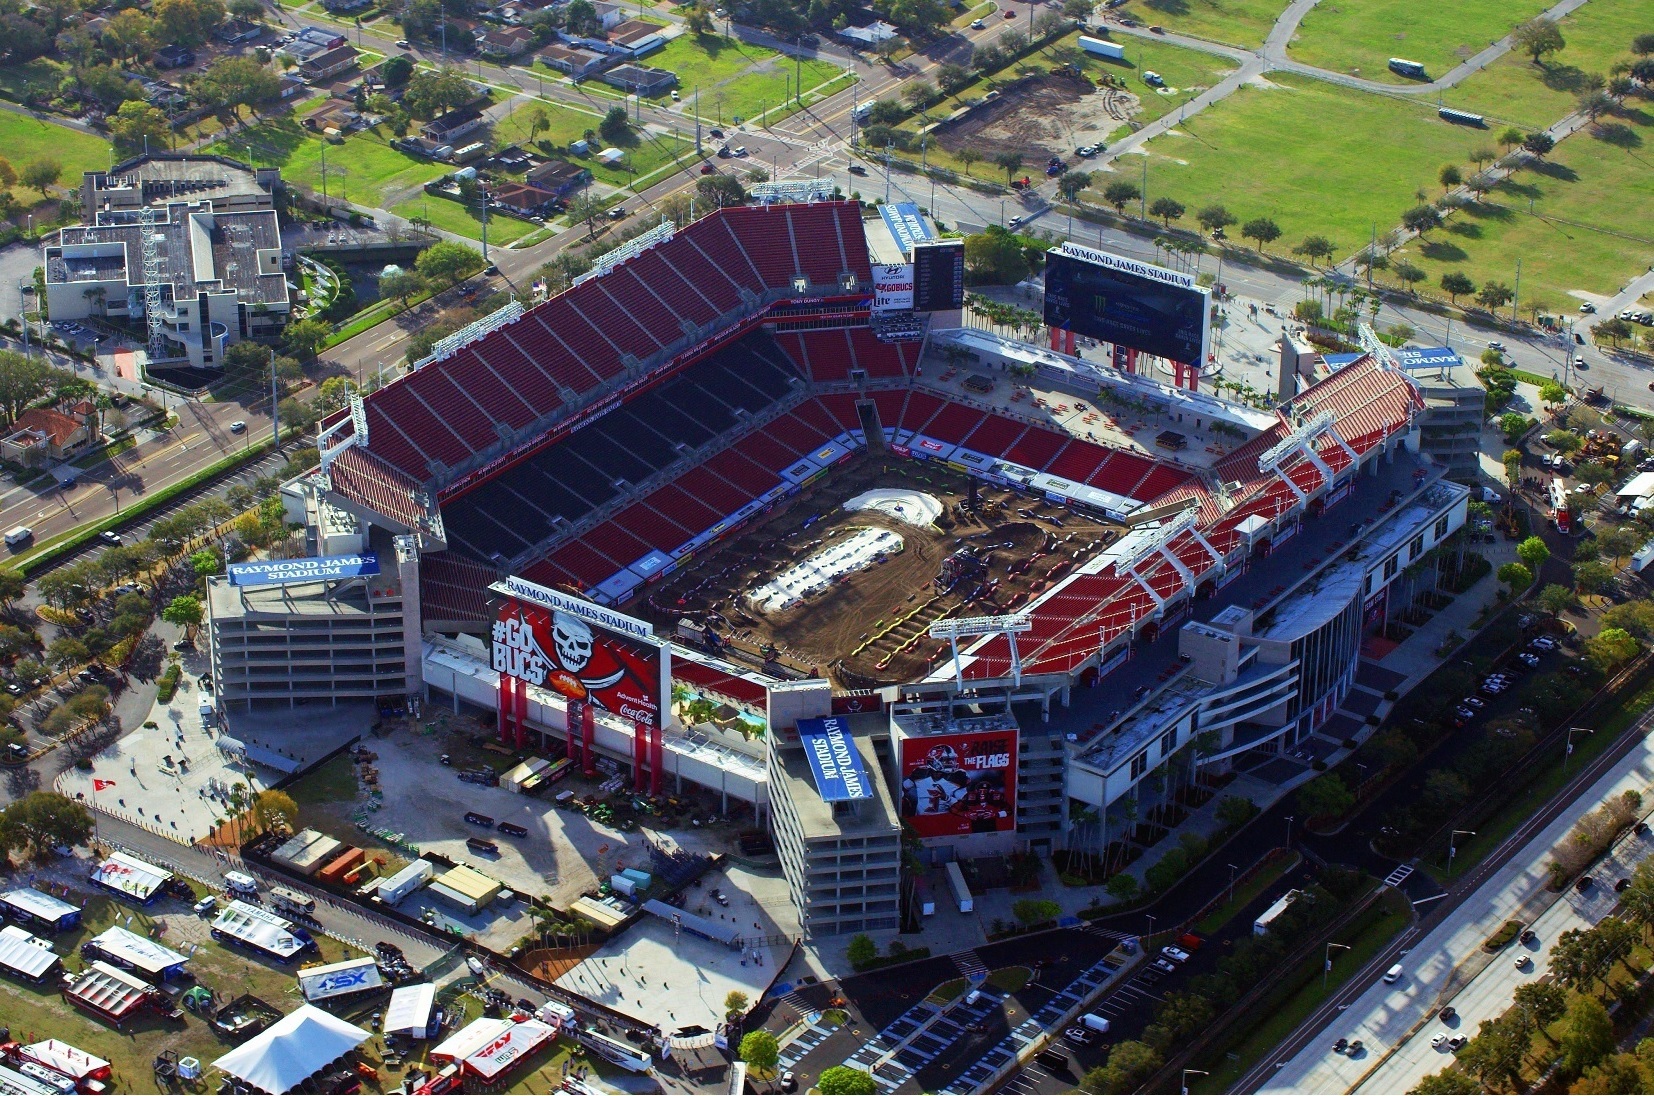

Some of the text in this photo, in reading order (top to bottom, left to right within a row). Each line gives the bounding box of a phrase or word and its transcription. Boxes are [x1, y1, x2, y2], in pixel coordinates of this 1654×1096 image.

[1062, 244, 1191, 287] RAYMOND JAMES STADIUM
[874, 297, 891, 307] Lite
[1404, 355, 1459, 365] RAYMO
[233, 556, 376, 575] RAYMOND JAMES
[268, 566, 342, 580] STADIUM
[507, 579, 647, 637] RAYMOND JAMES STADIUM
[492, 617, 533, 652] #GO
[492, 640, 543, 685] BUCS
[812, 738, 839, 780] STADIUM
[823, 718, 864, 797] RAYMOND JAMES
[964, 753, 1010, 769] THE FLAGS
[246, 906, 276, 922] YAMAHA
